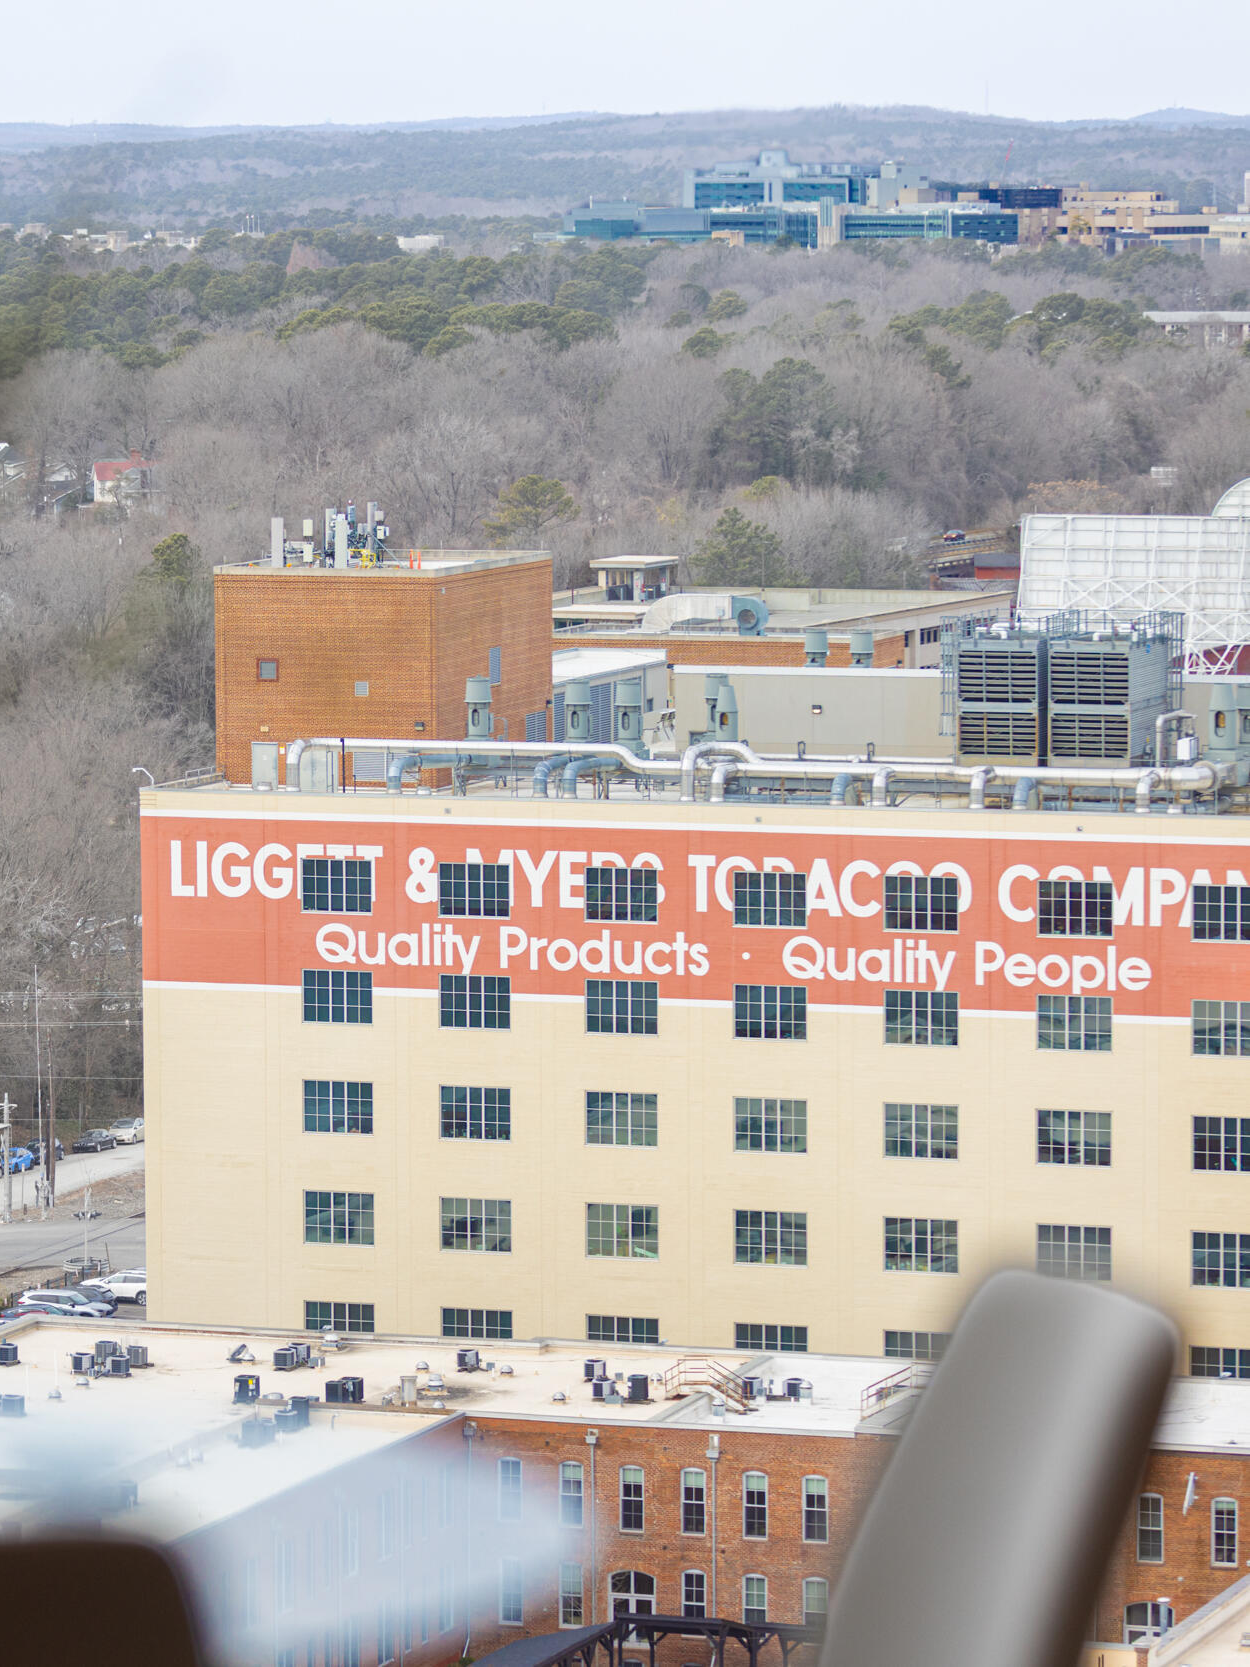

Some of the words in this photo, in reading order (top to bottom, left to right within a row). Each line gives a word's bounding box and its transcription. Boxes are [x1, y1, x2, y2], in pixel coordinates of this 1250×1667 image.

[405, 846, 439, 904] &
[688, 854, 973, 918] TOACO
[316, 922, 482, 974] Quality
[500, 926, 711, 976] Products
[782, 936, 956, 991] Quality
[975, 941, 1152, 995] People
